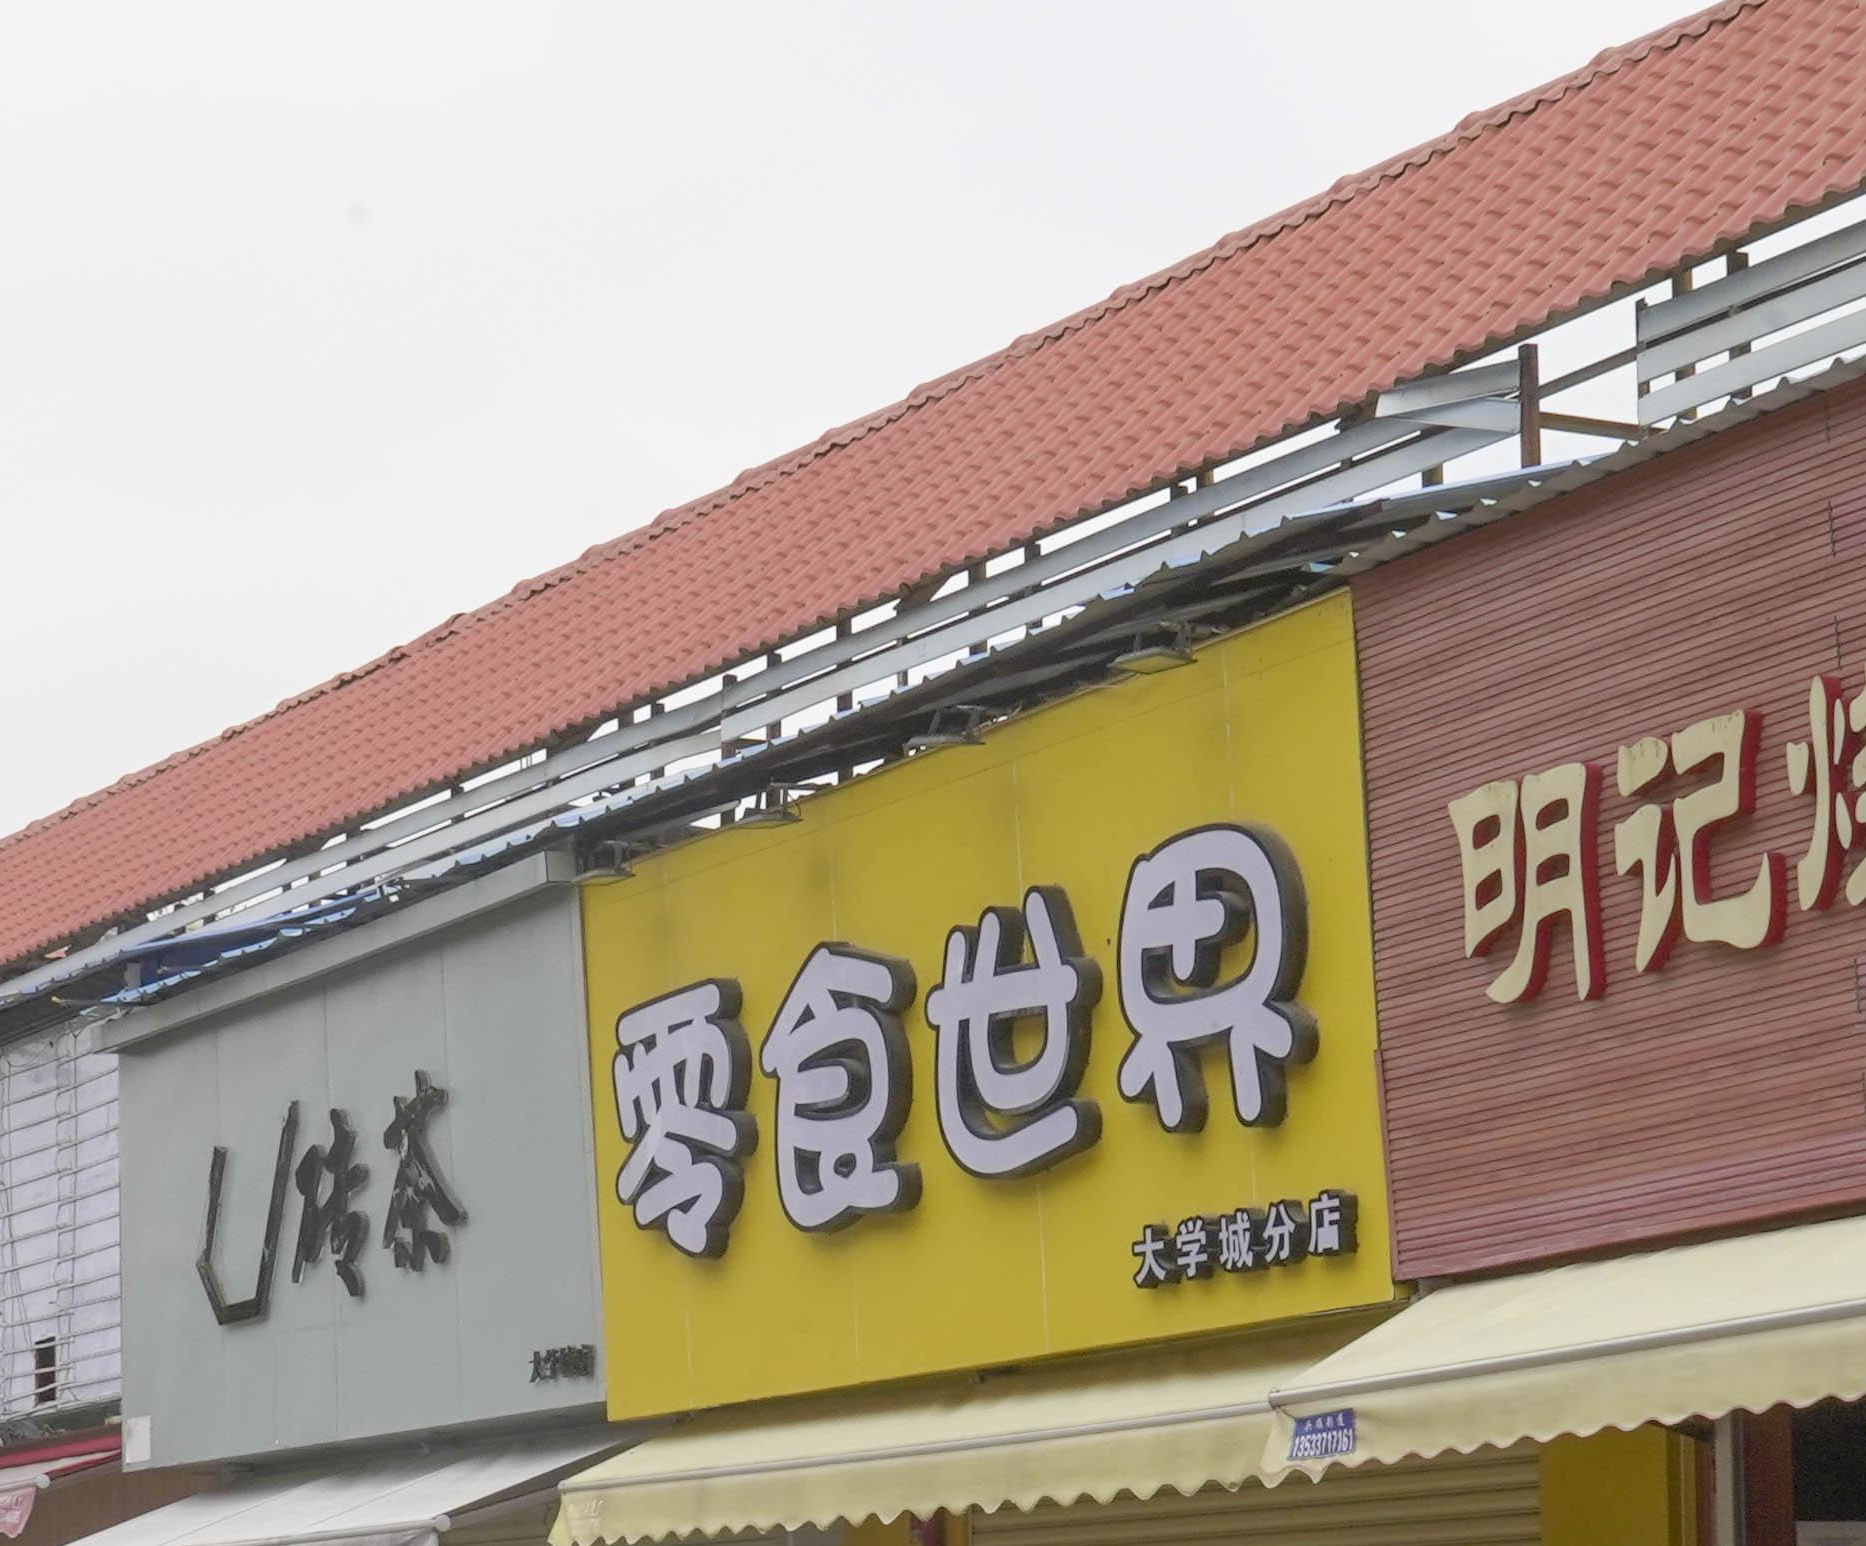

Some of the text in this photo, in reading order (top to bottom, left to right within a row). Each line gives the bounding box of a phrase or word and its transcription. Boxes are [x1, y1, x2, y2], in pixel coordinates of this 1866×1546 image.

[613, 823, 1318, 1258] 零食世界
[1133, 1191, 1358, 1288] 大学城分店
[1292, 1428, 1353, 1458] 13533717161
